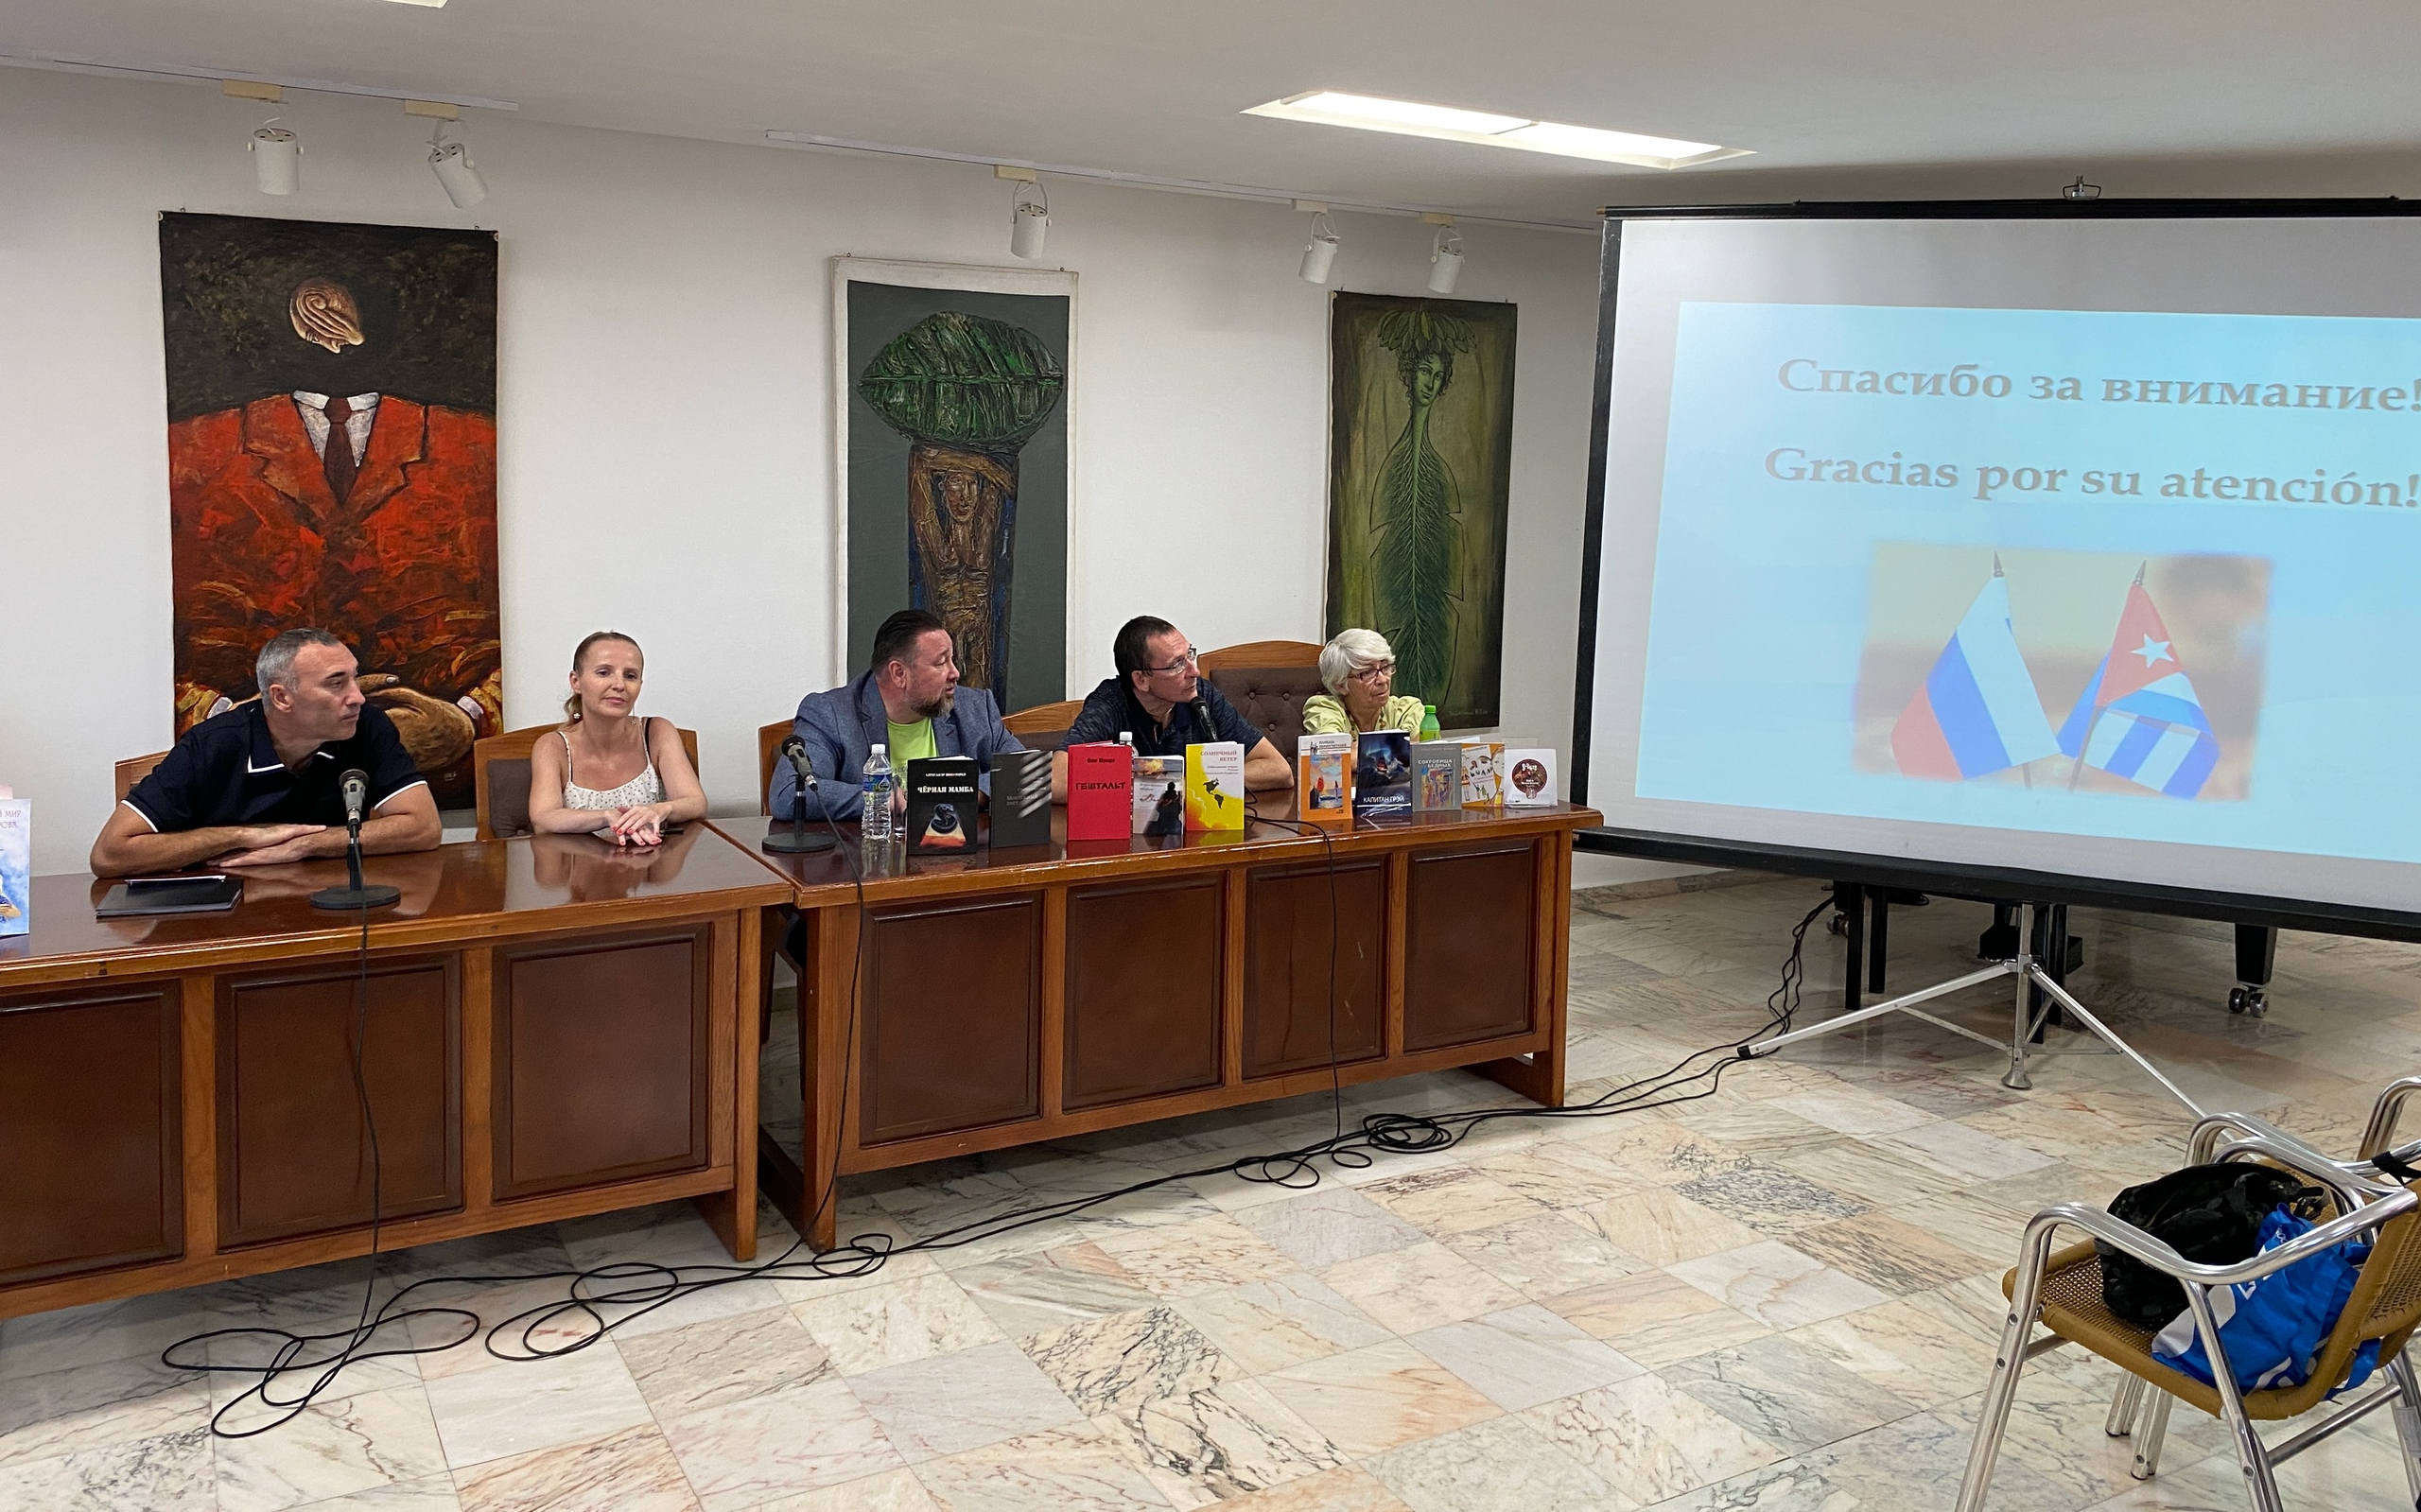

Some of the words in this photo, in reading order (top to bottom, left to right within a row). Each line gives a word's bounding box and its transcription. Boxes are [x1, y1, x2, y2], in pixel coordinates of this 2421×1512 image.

[1777, 358, 2012, 398] Спасибо
[2029, 375, 2083, 401] за
[2100, 378, 2421, 412] внимание!
[1764, 447, 1959, 488] Gracias
[1973, 464, 2068, 500] por
[2081, 470, 2143, 496] su
[2159, 467, 2421, 508] atención!
[917, 785, 947, 793] ЧЁРНАЯ
